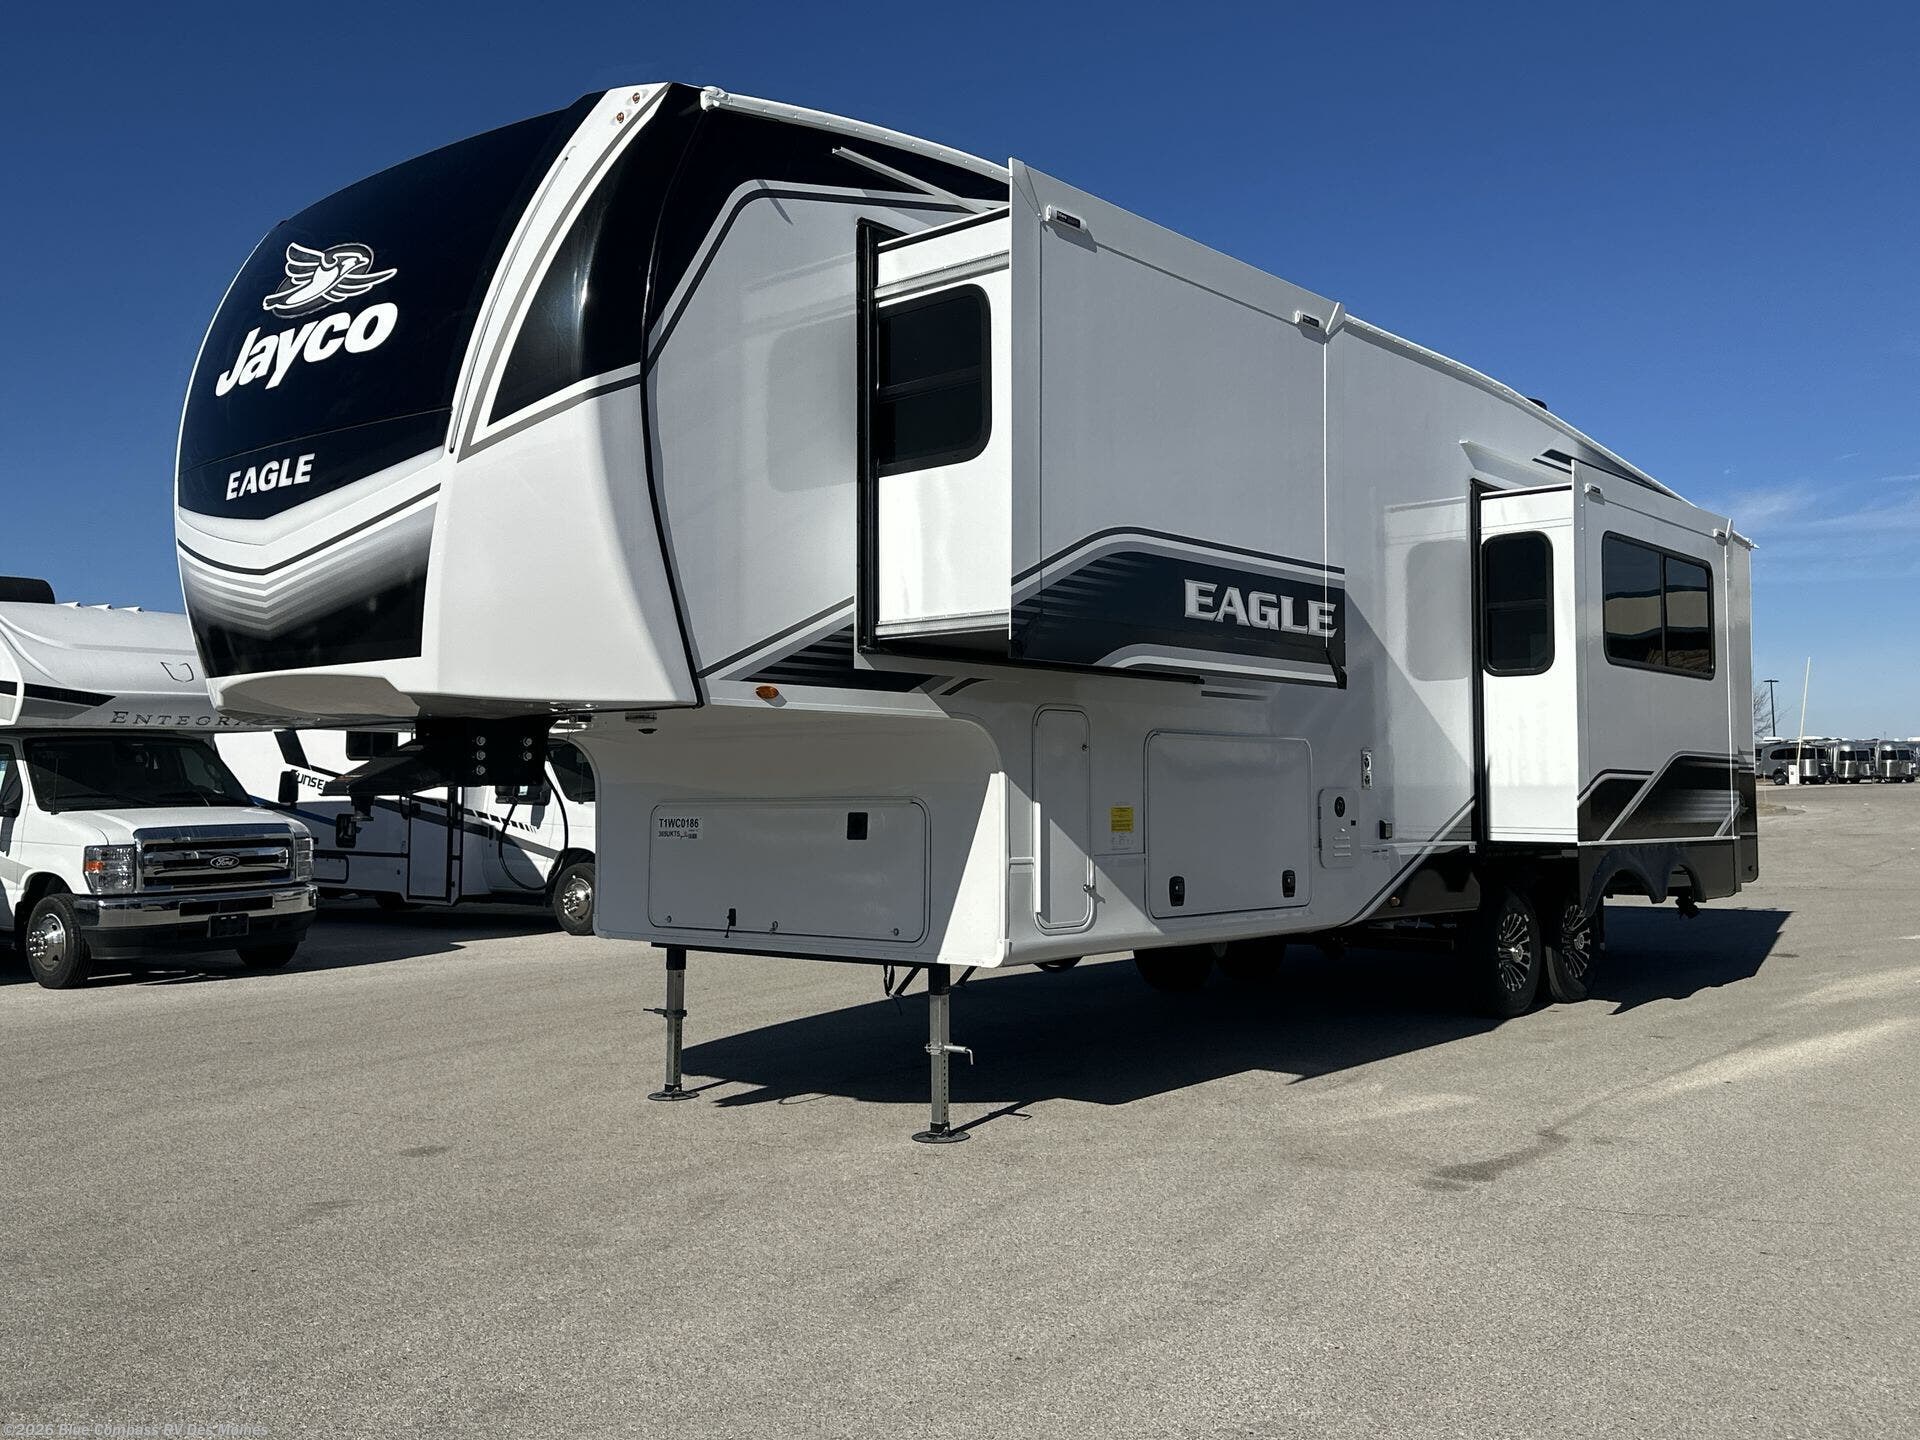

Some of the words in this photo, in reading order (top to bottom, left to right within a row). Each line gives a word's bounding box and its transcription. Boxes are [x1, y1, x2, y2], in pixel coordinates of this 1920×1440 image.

[215, 302, 398, 397] Jayco
[225, 453, 315, 501] EAGLE
[1184, 578, 1338, 639] EAGLE
[658, 818, 699, 828] T1WC0186
[215, 856, 235, 866] Ford
